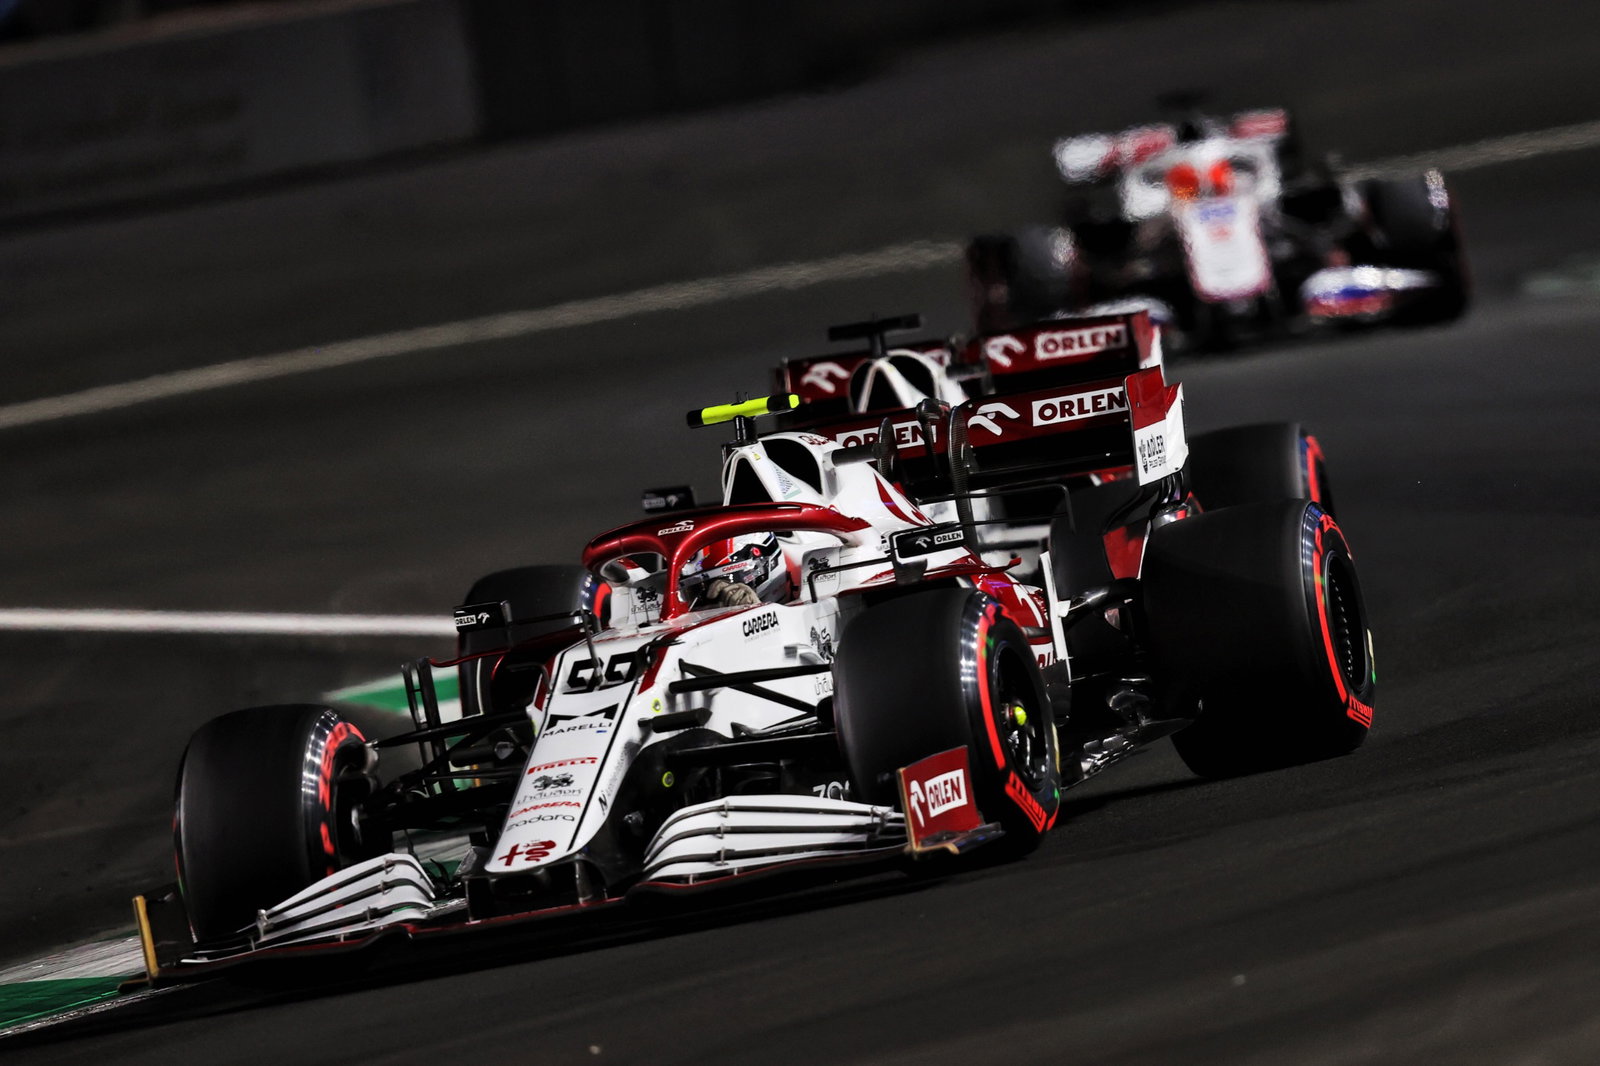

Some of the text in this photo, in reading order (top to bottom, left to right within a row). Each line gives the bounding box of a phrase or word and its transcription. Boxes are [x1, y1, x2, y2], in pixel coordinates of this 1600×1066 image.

[1042, 328, 1123, 354] ORLEN
[1037, 391, 1126, 421] ORLEN
[842, 423, 934, 448] OREN
[935, 532, 962, 543] ORLEN
[455, 616, 476, 625] ORLEN
[742, 610, 780, 637] CARRERA
[541, 722, 613, 739] MARELLI
[527, 756, 599, 775] PIRELLI
[928, 776, 962, 811] ORLEN
